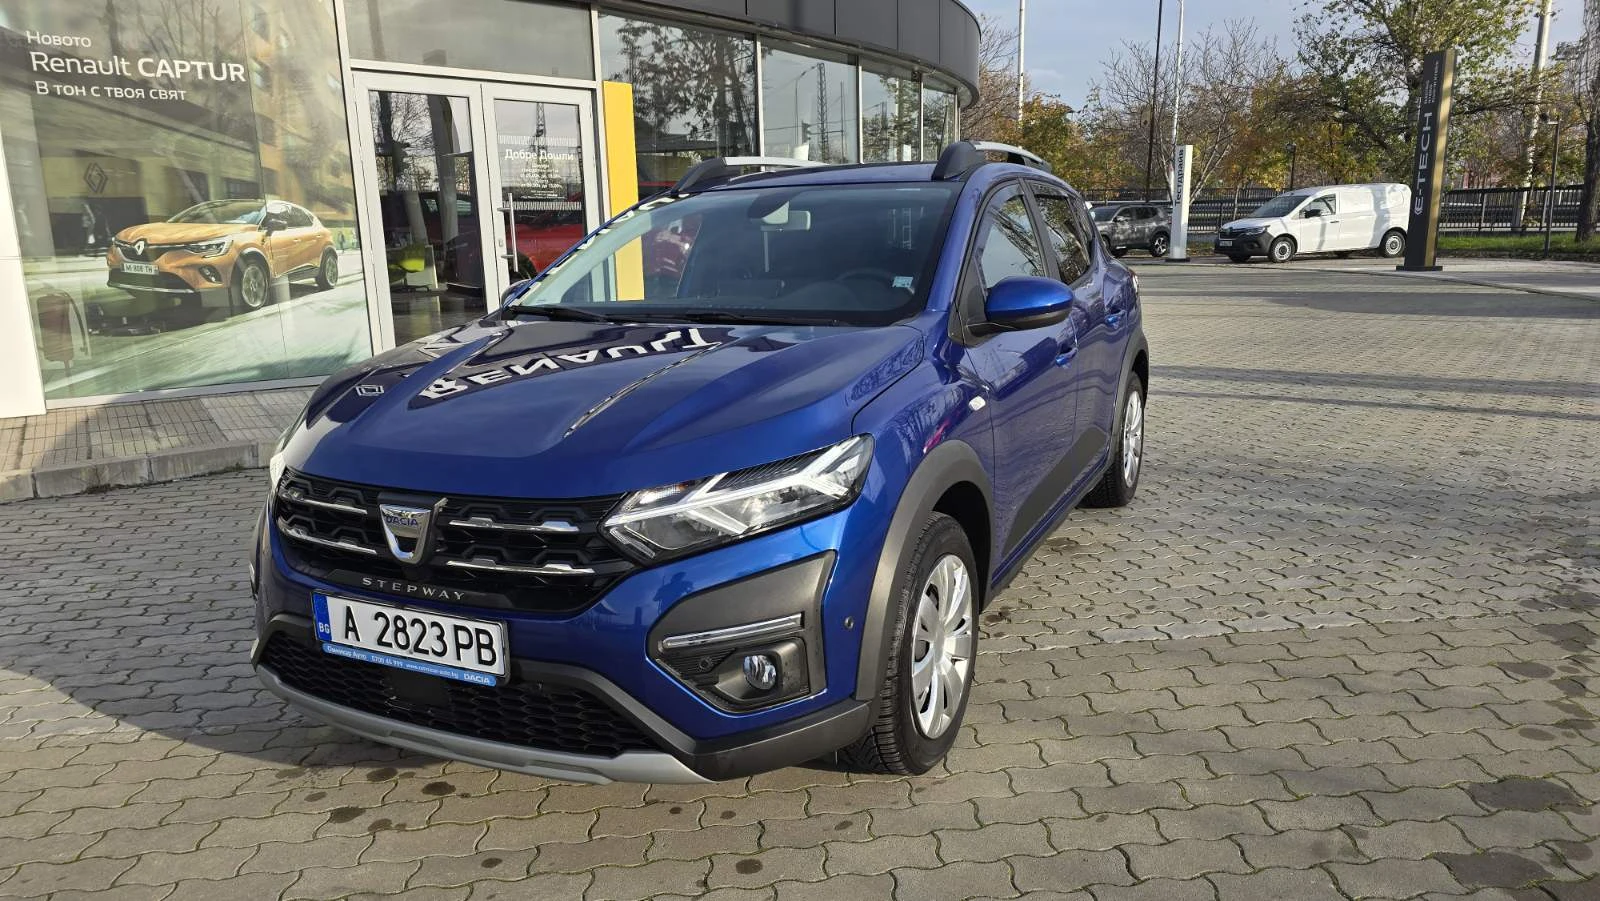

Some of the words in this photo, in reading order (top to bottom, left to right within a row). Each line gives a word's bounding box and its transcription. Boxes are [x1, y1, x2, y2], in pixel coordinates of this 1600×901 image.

[26, 30, 92, 48] Новото
[29, 51, 131, 76] Renault
[137, 57, 247, 82] CAPTUR
[35, 80, 49, 96] В
[52, 84, 86, 97] тон
[90, 85, 101, 97] с
[103, 86, 145, 100] твоя
[149, 88, 187, 101] свят
[504, 149, 537, 162] Добре
[539, 150, 574, 162] Дошли
[1414, 112, 1433, 214] E-TECH
[385, 514, 419, 527] DACIA
[362, 577, 465, 600] STEPWAY
[318, 621, 331, 634] BG
[343, 605, 361, 643] A
[373, 610, 449, 658] 2823
[453, 624, 497, 666] PB
[463, 673, 490, 685] DACIA
